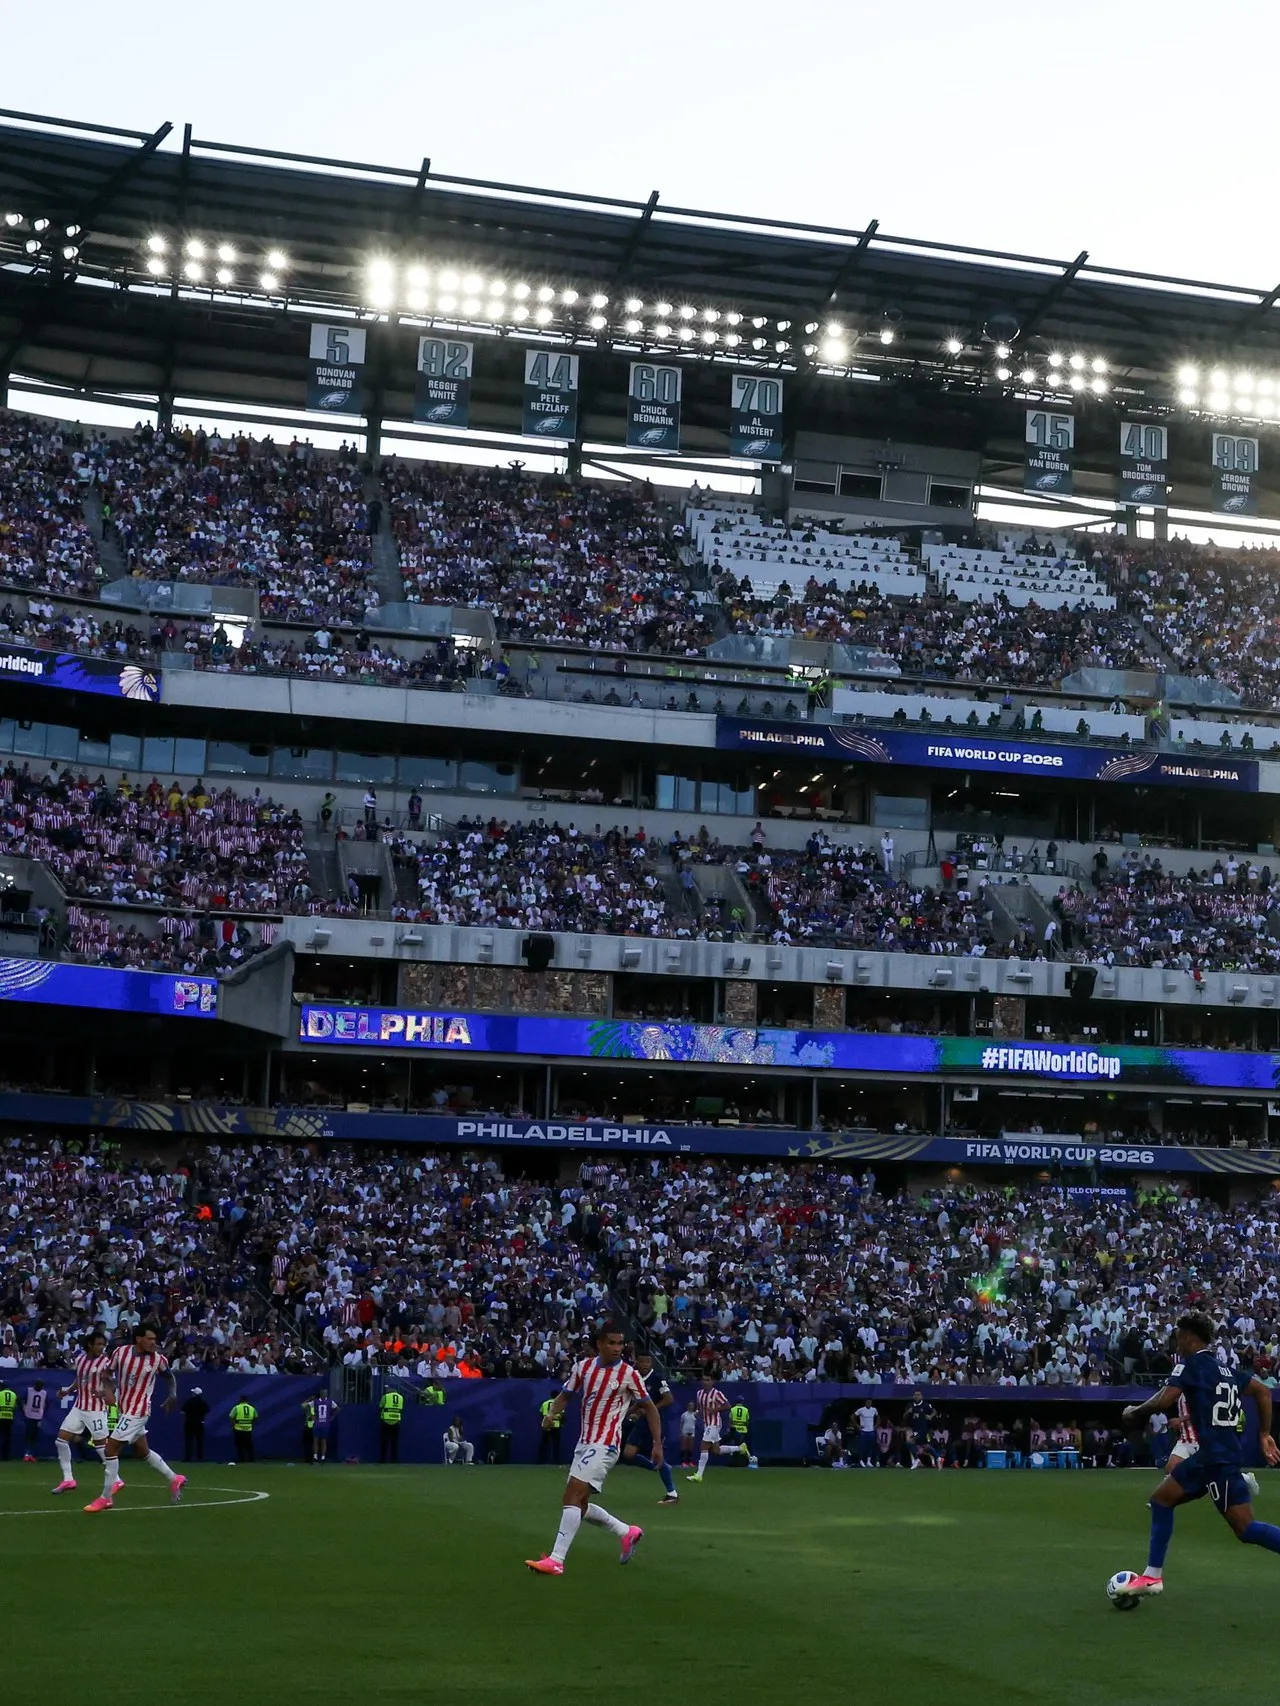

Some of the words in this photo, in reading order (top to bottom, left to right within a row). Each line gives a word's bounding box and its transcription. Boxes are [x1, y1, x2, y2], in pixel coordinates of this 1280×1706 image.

[326, 327, 350, 366] 5
[422, 339, 469, 380] 92
[316, 367, 355, 379] DONOVAN
[529, 352, 573, 392] 44
[318, 377, 352, 388] McNABB
[428, 380, 458, 392] REGGIE
[633, 365, 678, 404] 60
[429, 389, 456, 400] WHITE
[541, 393, 560, 403] PETE
[736, 377, 779, 416] 70
[531, 402, 569, 414] RETZLAFF
[640, 405, 667, 415] CHUCK
[633, 413, 673, 425] BEDNARIK
[752, 417, 762, 426] AL
[739, 424, 774, 437] WISTERT
[1030, 413, 1070, 450] 15
[1124, 424, 1164, 461] 40
[1038, 451, 1060, 461] STEVE
[1216, 436, 1256, 473] 99
[1028, 458, 1044, 468] VAN
[1045, 460, 1069, 471] BUREN
[1136, 463, 1152, 472] TOM
[1122, 470, 1166, 482] BROOKSHIER
[1220, 473, 1250, 485] JEROME
[1222, 482, 1249, 493] BROWN
[739, 729, 825, 747] PHILADELPHIA
[927, 746, 953, 757] FIFA
[954, 748, 996, 761] WORLD
[998, 751, 1022, 763] CUP
[1022, 753, 1064, 766] 2026
[1160, 765, 1239, 781] PHILADELPHIA
[299, 1009, 472, 1044] DELPHIA
[982, 1047, 1121, 1079] #FIFAWorldCup
[457, 1121, 672, 1145] PHILADELPHIA
[966, 1143, 1002, 1158] FIFA
[1003, 1144, 1062, 1160] WORLD
[1065, 1146, 1097, 1161] CUP
[1099, 1148, 1155, 1164] 2026
[92, 1419, 103, 1431] 13
[116, 1418, 132, 1431] 15
[582, 1448, 597, 1465] 2
[1206, 1481, 1220, 1501] 0
